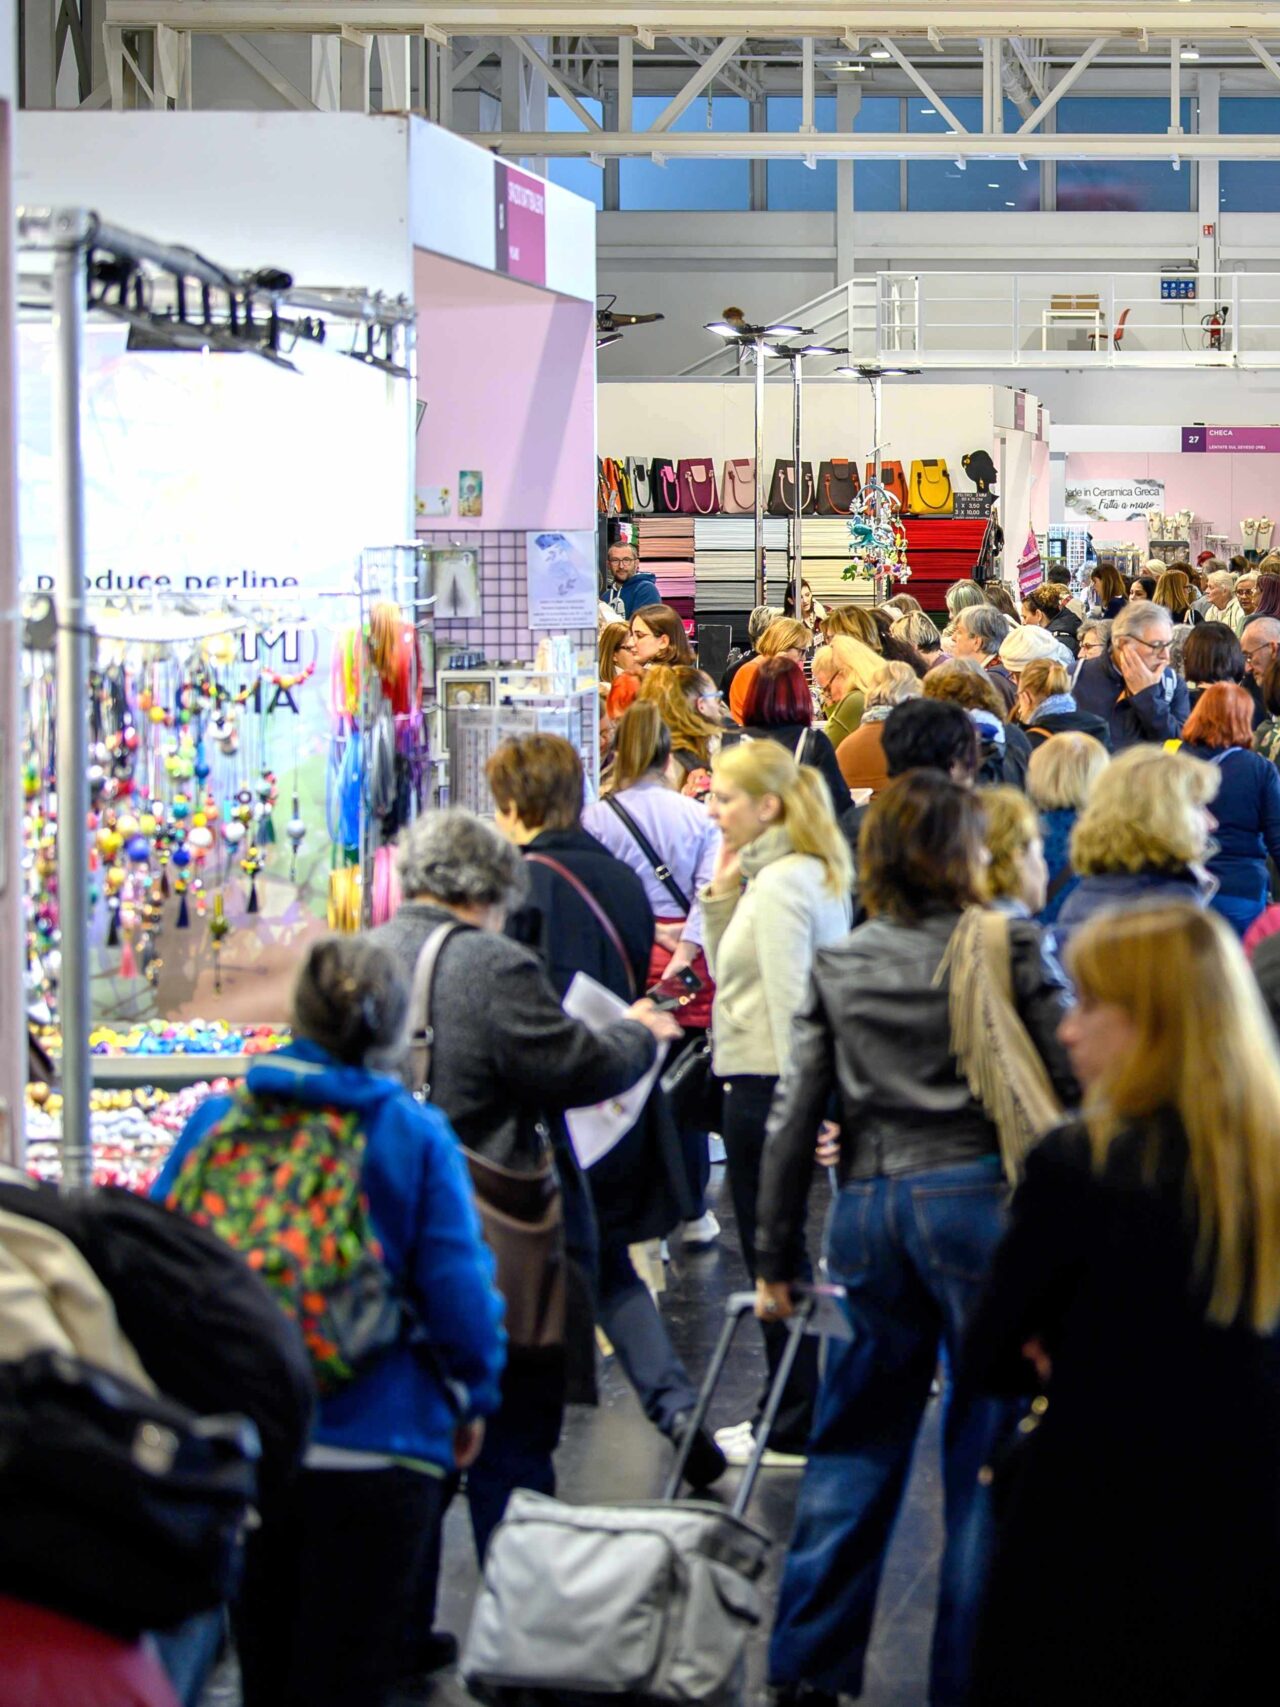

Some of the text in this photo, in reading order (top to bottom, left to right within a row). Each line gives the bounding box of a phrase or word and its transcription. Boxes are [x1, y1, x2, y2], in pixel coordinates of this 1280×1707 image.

[1188, 435, 1200, 444] 27
[1092, 487, 1133, 497] Ceramica
[1134, 487, 1160, 497] Greca
[1098, 498, 1120, 510] Fatta
[1121, 501, 1128, 509] a
[37, 569, 171, 591] poduce
